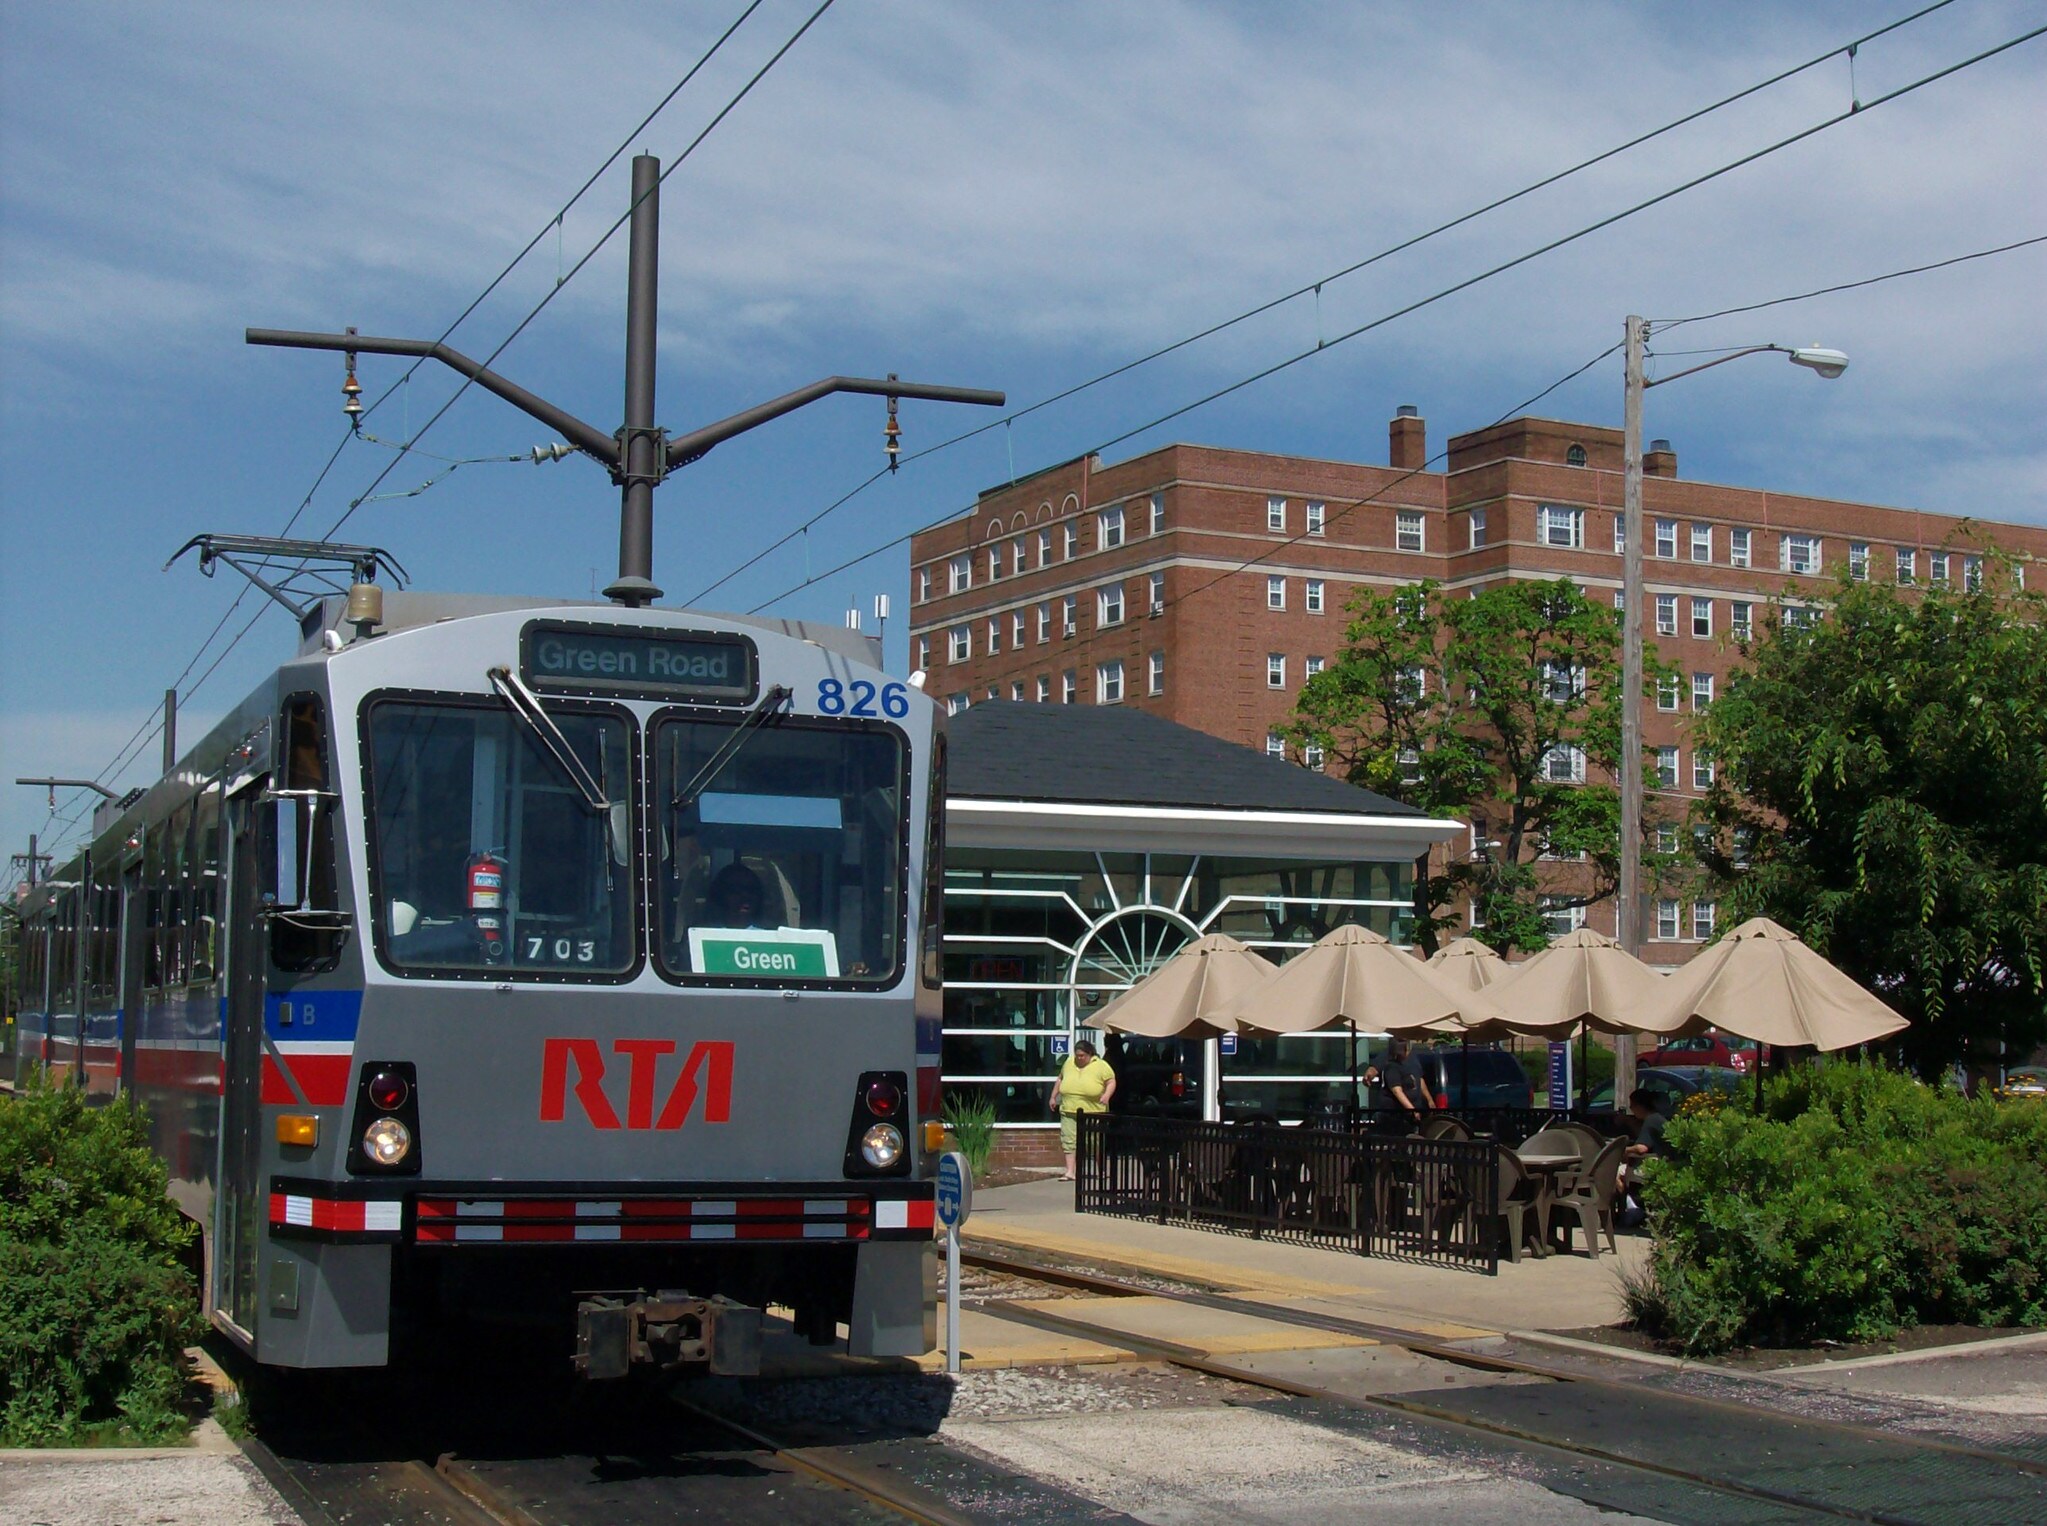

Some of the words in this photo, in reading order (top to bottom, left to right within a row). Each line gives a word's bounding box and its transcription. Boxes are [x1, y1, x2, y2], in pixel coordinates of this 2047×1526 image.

[539, 639, 637, 674] Green
[649, 646, 728, 679] Road
[818, 678, 909, 719] 826
[734, 946, 796, 970] Green
[303, 1004, 315, 1025] B
[540, 1038, 735, 1130] RTA
